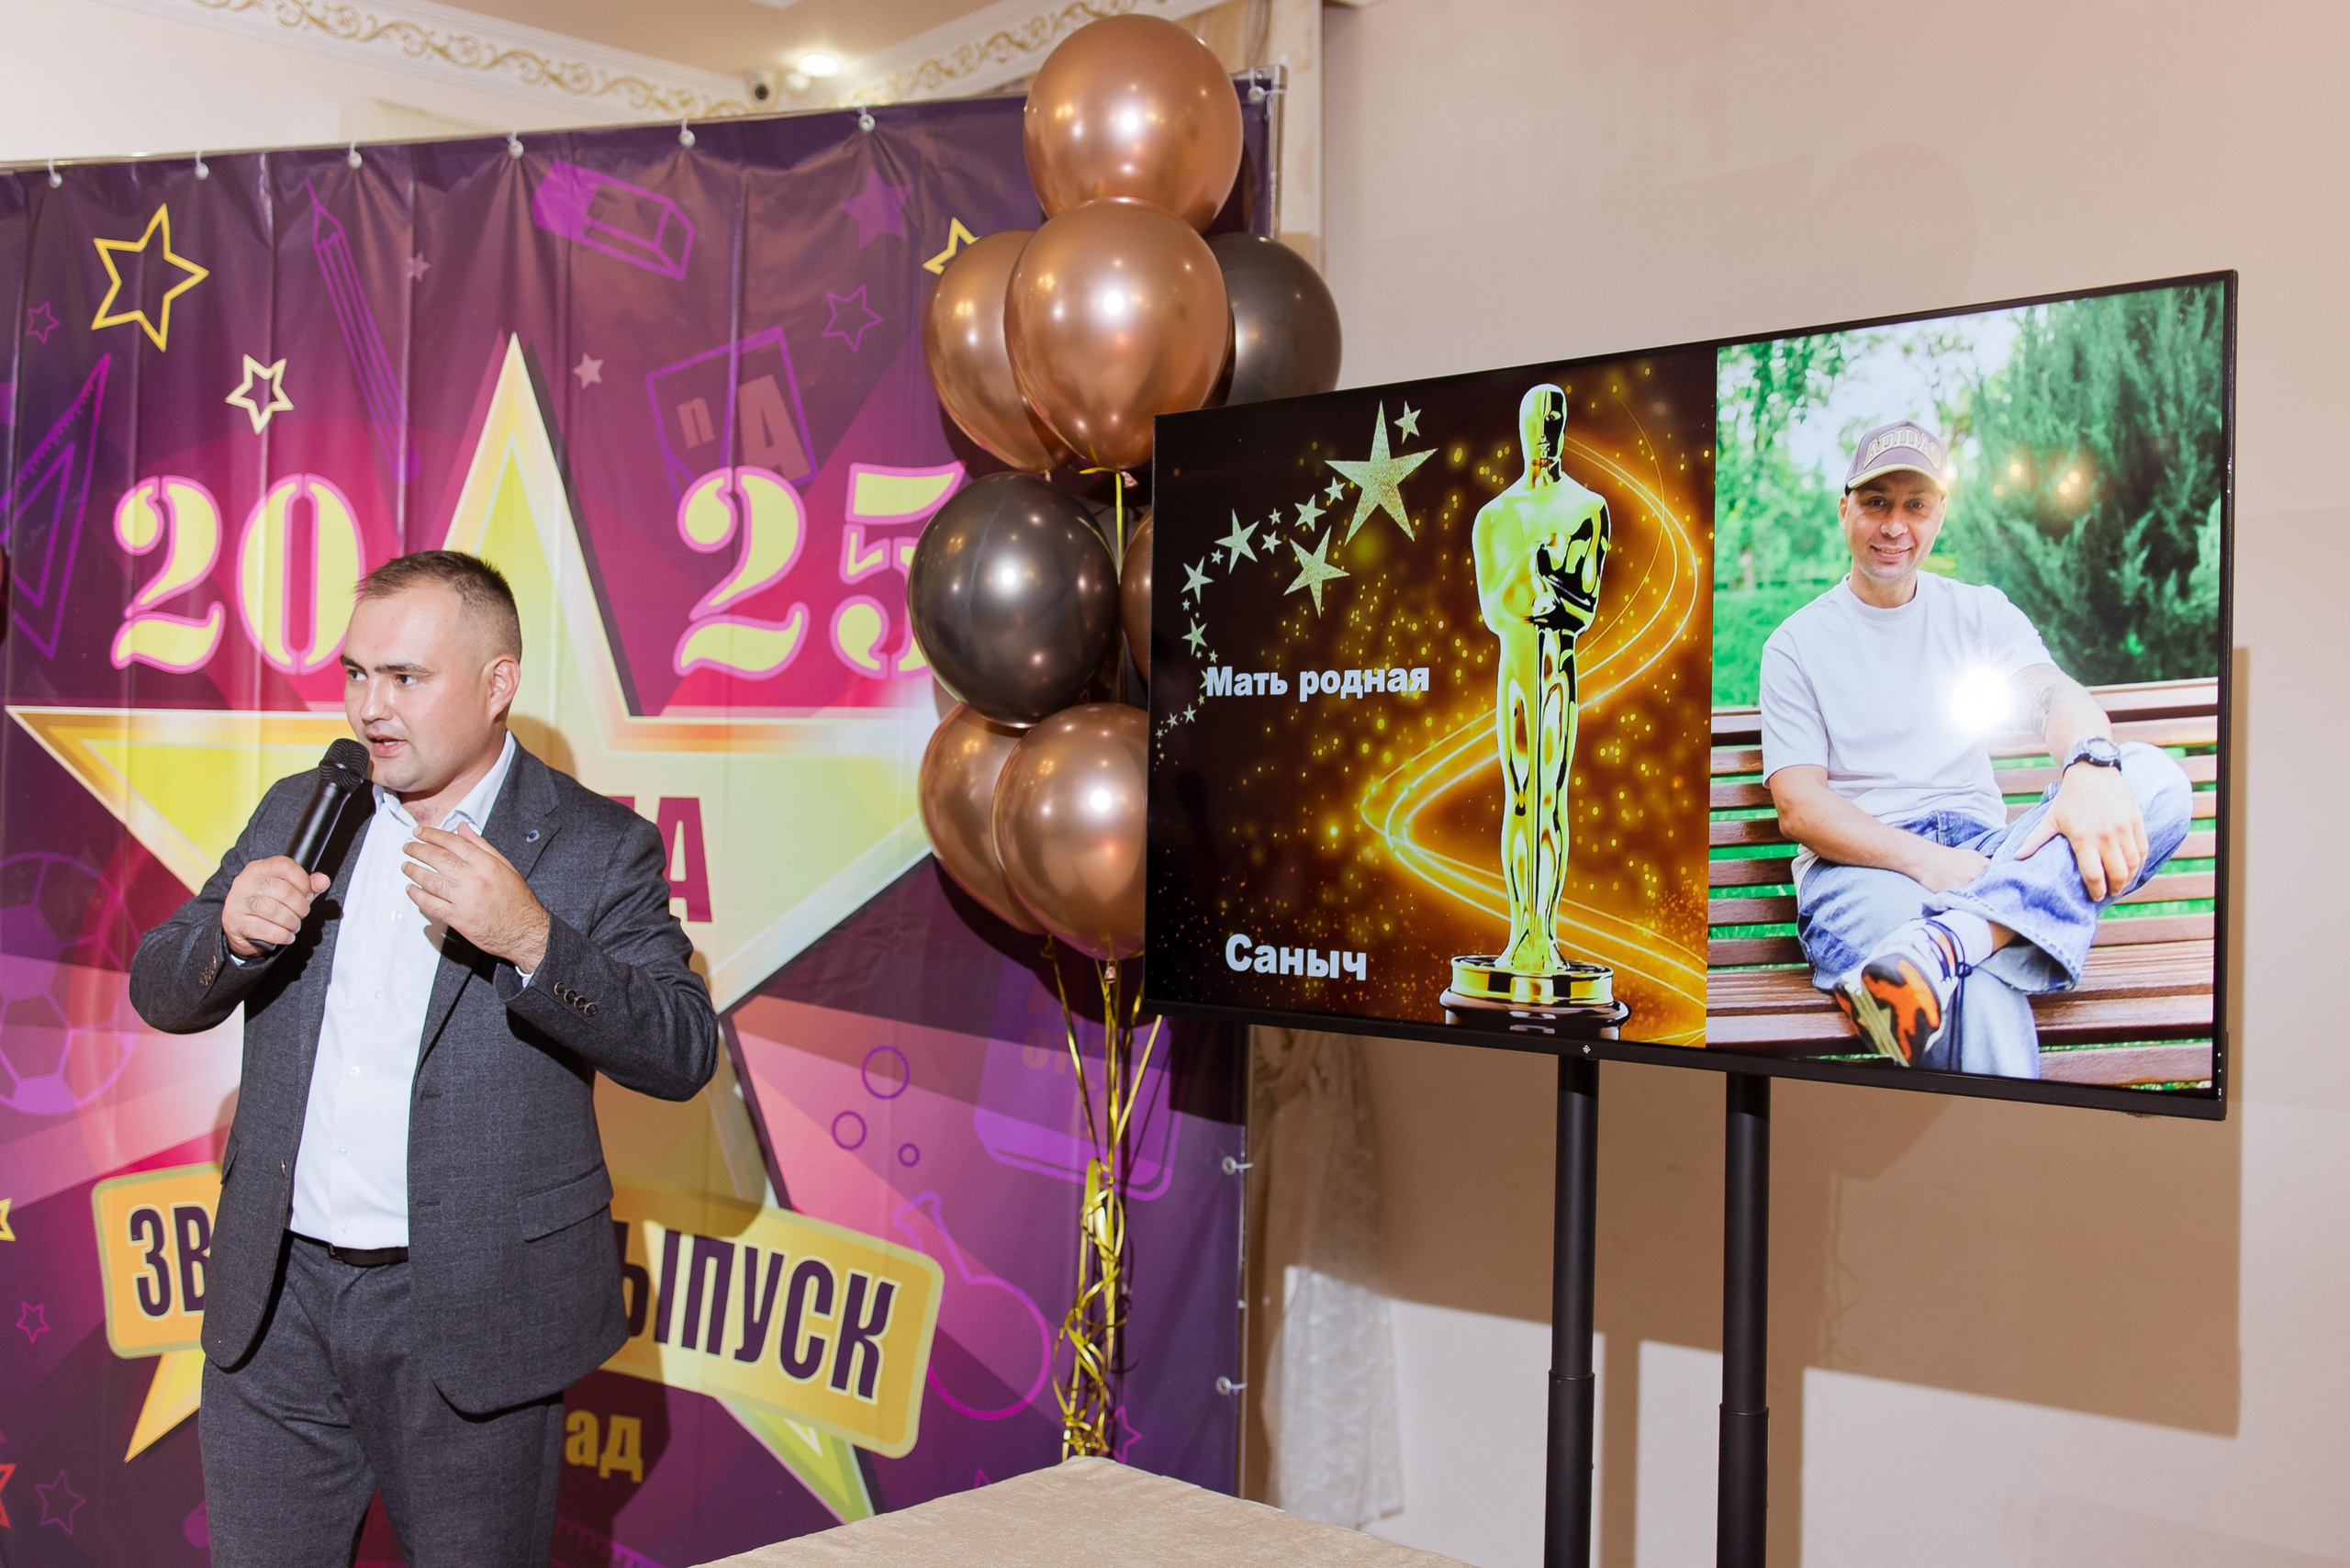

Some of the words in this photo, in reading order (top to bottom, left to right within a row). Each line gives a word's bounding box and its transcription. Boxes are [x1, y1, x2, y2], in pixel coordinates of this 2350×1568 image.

[1864, 428, 1941, 466] ADIDAS
[110, 473, 366, 675] 20
[673, 461, 966, 680] 25
[1205, 666, 1288, 697] Мать
[1299, 667, 1429, 702] родная
[1225, 934, 1367, 980] Саныч
[611, 1220, 897, 1400] ЫПУСК
[564, 1408, 644, 1484] ад
